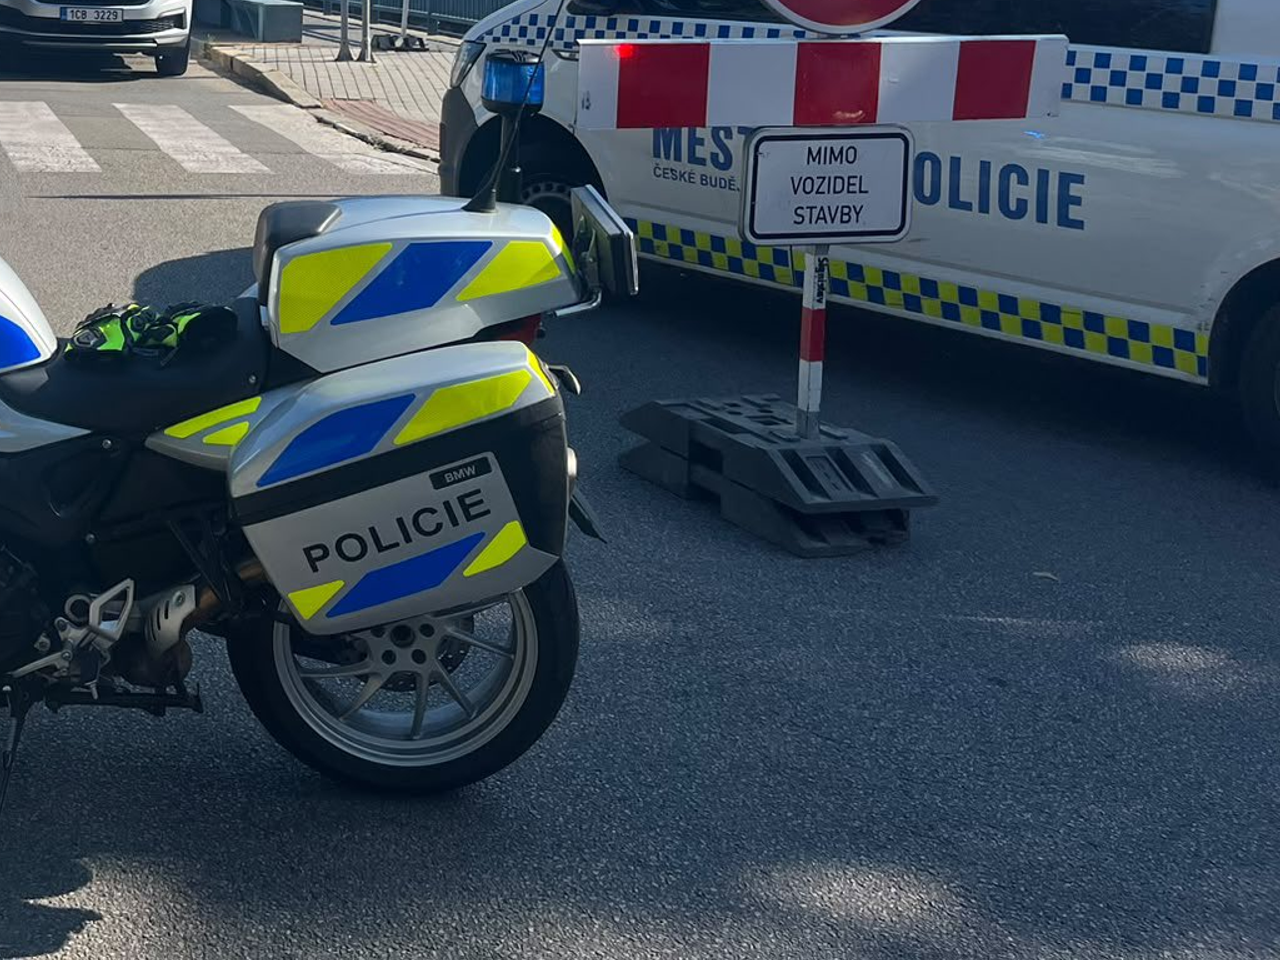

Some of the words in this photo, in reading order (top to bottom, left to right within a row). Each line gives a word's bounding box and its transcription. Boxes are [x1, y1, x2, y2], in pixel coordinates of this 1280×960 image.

[70, 10, 88, 20] 1CB
[94, 10, 118, 20] 3229
[806, 146, 858, 165] MIMO
[653, 162, 696, 184] ČESKÉ
[790, 175, 869, 195] VOZIDEL
[793, 205, 864, 225] STAVBY
[444, 465, 477, 483] BMW
[302, 488, 492, 573] POLICIE
